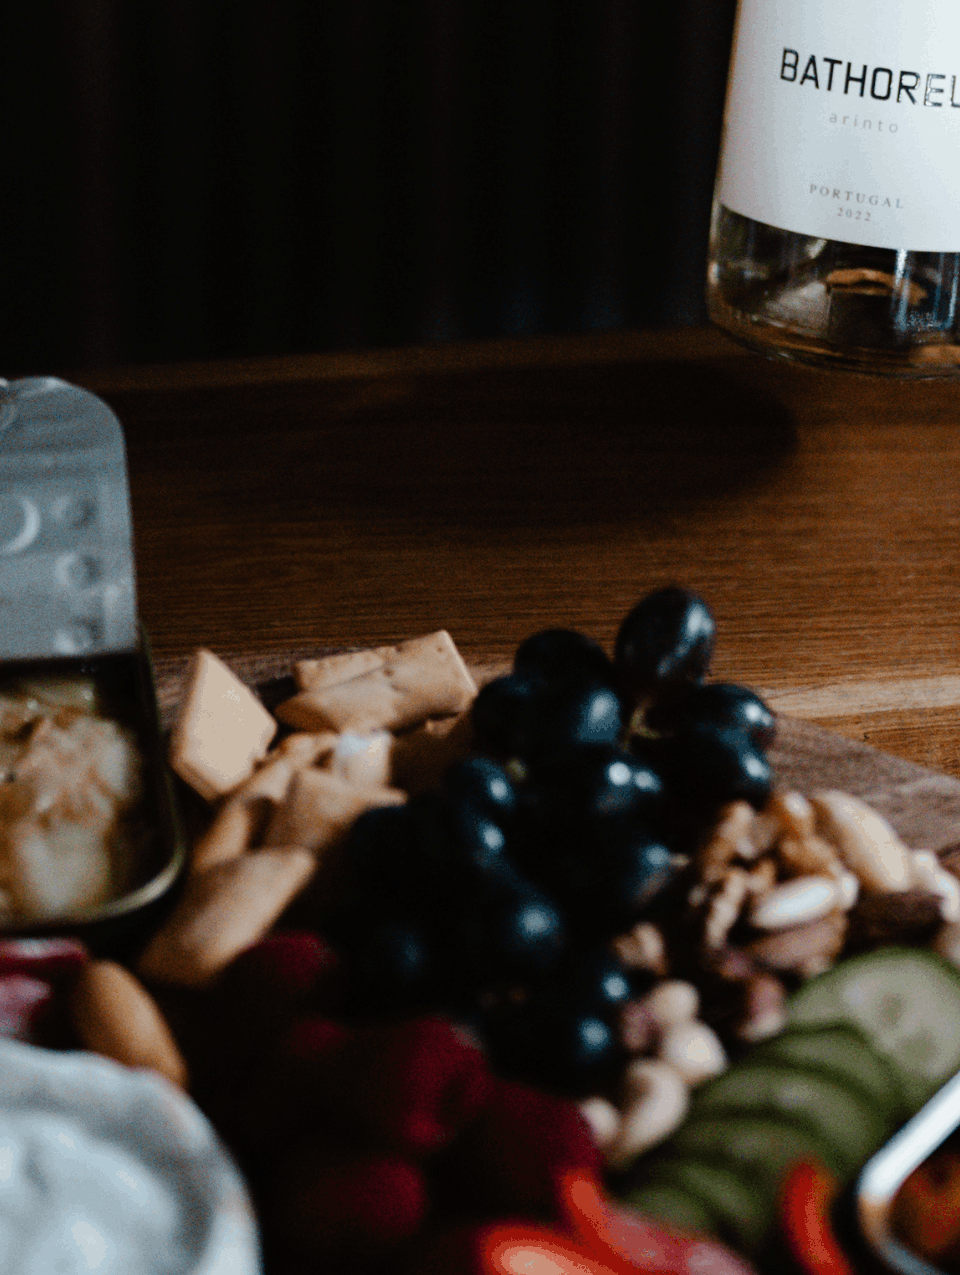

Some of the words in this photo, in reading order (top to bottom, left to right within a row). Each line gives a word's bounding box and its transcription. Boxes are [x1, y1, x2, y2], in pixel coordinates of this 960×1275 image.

[829, 111, 899, 134] arinto
[808, 183, 904, 209] PORTUGAL
[837, 207, 872, 222] 2022
